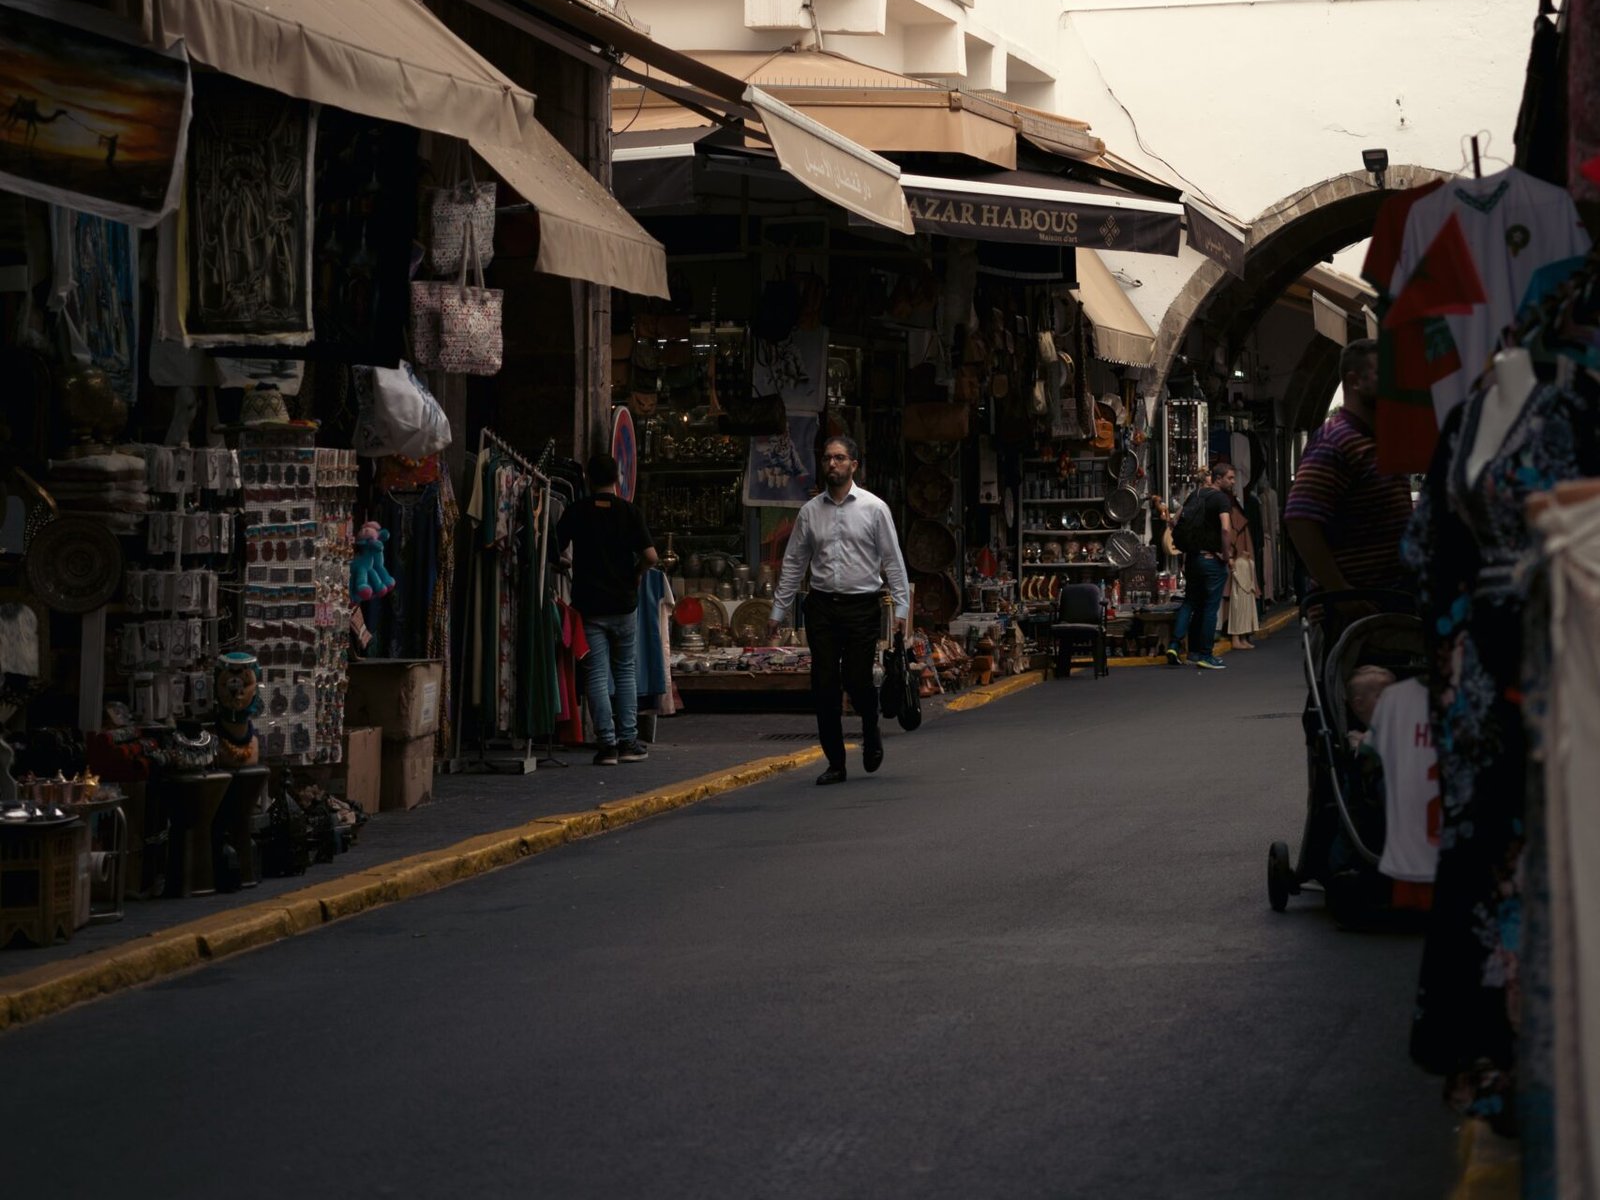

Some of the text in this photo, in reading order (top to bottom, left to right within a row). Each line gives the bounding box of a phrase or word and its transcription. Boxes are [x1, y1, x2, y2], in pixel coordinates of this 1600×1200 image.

[909, 197, 1079, 234] AZAR HABOUS
[1038, 232, 1062, 242] Maison
